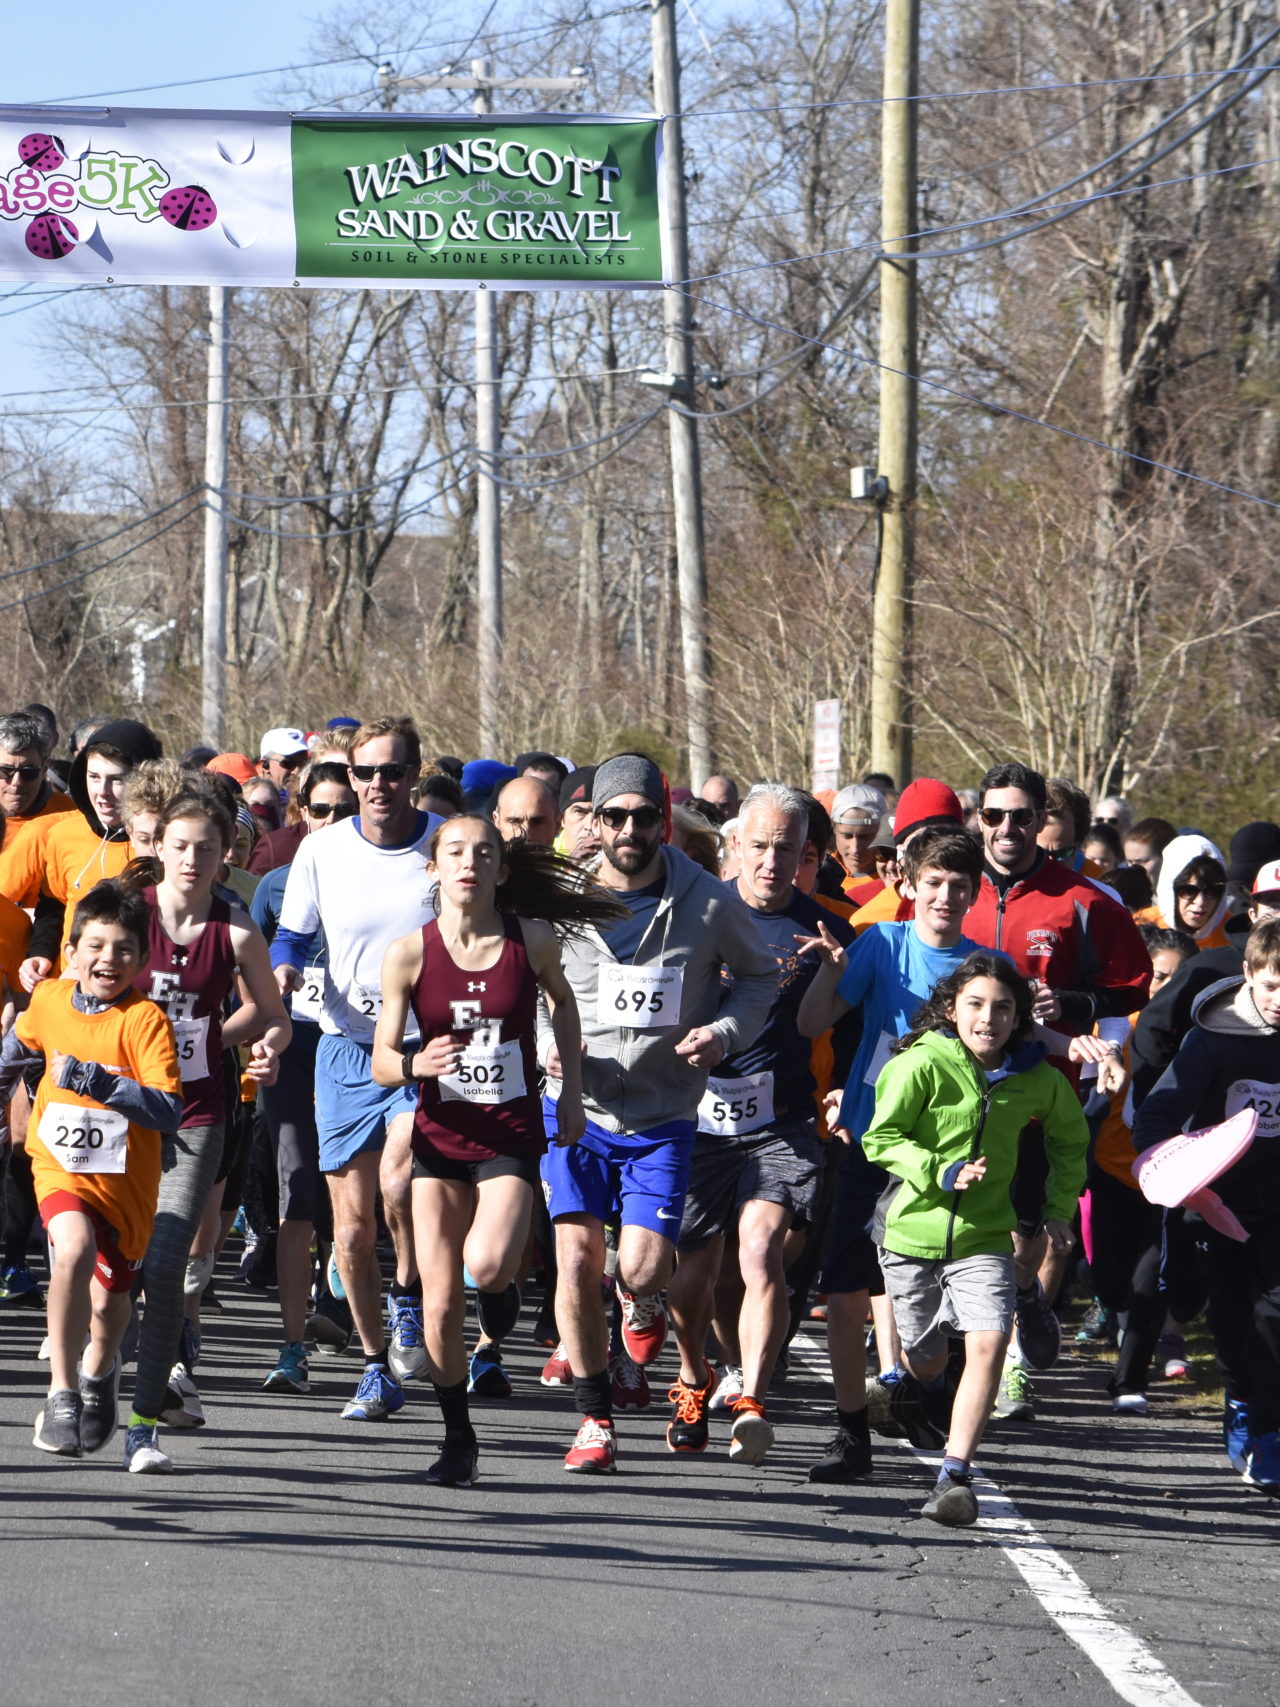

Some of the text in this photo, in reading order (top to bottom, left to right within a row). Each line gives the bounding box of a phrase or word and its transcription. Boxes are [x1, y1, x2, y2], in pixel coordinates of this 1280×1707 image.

[345, 137, 621, 204] WAINSCOTT
[78, 158, 163, 216] 5K
[337, 208, 632, 243] SAND & GRAVEL
[350, 250, 626, 266] SOIL & STONE SPECIALISTS
[614, 988, 664, 1014] 695
[458, 1064, 505, 1084] 502
[463, 1087, 504, 1096] Isabella
[712, 1095, 758, 1122] 555
[54, 1125, 104, 1150] 220
[66, 1153, 90, 1164] Sam
